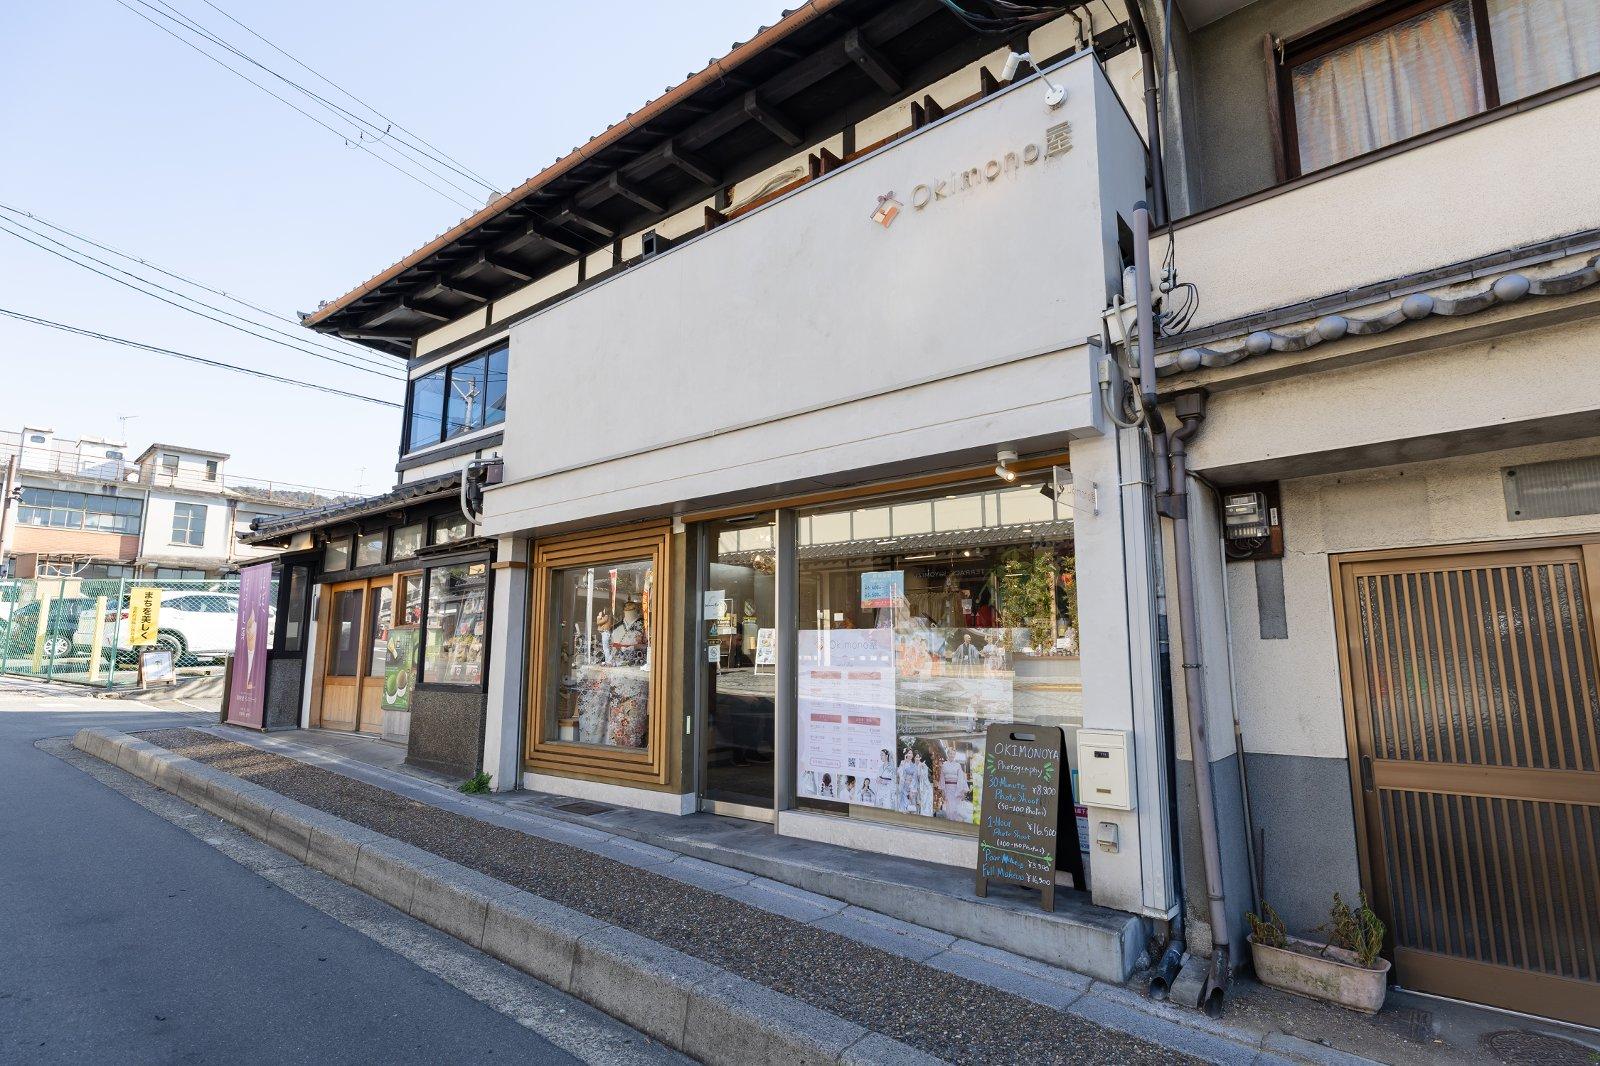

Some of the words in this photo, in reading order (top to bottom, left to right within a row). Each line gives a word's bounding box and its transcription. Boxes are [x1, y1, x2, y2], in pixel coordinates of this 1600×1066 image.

[910, 120, 1074, 210] Okimono屋
[995, 742, 1059, 760] OKIMONOYA
[997, 760, 1043, 778] Photography
[995, 789, 1016, 802] Photo
